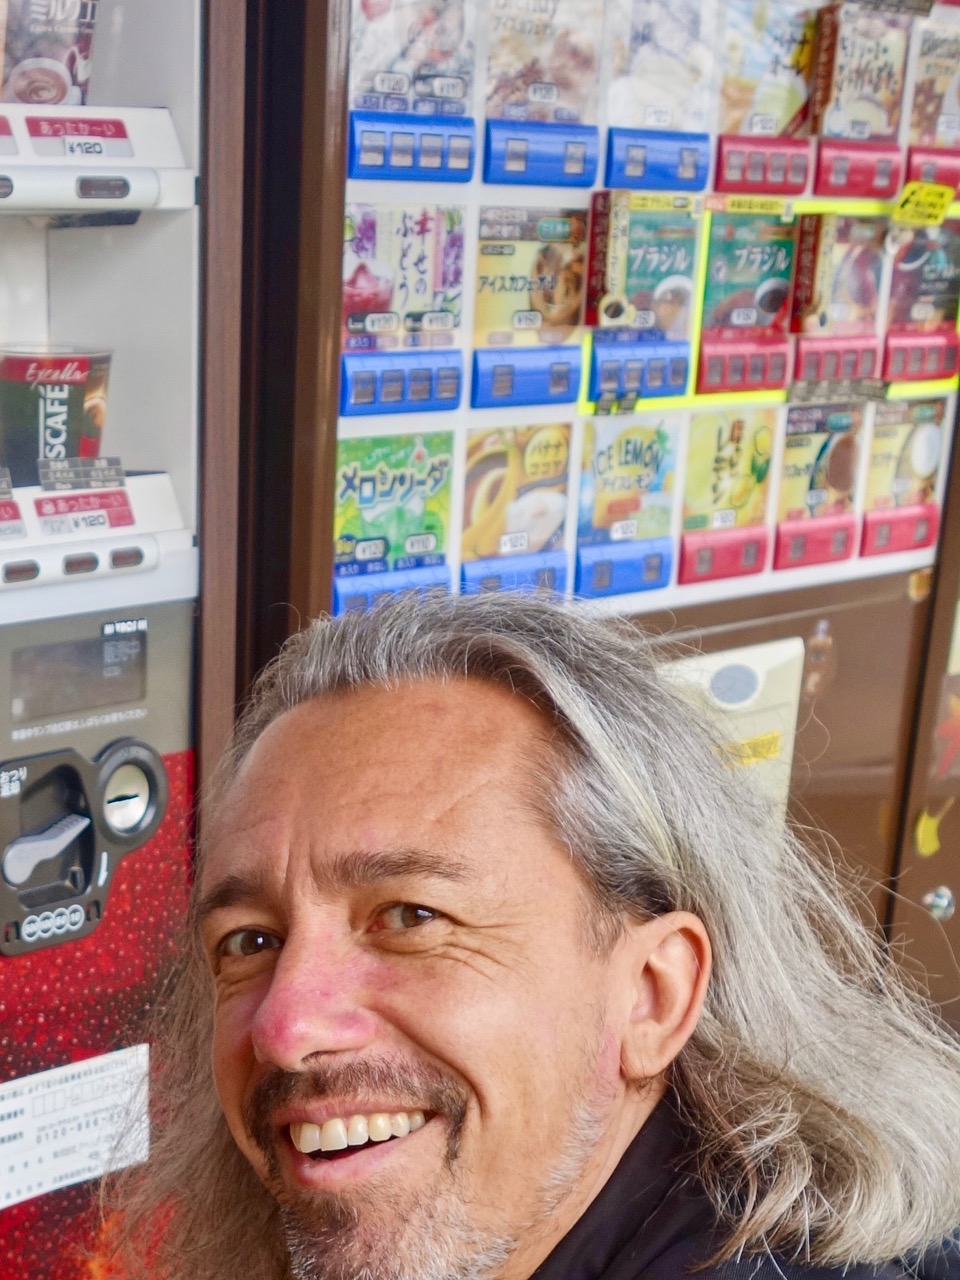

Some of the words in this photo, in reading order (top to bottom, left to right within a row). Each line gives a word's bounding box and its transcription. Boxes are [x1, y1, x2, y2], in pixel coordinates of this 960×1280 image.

[69, 142, 103, 154] ¥120
[630, 243, 689, 272] ブラジル
[735, 244, 790, 272] ブラジル
[72, 513, 106, 529] ¥120
